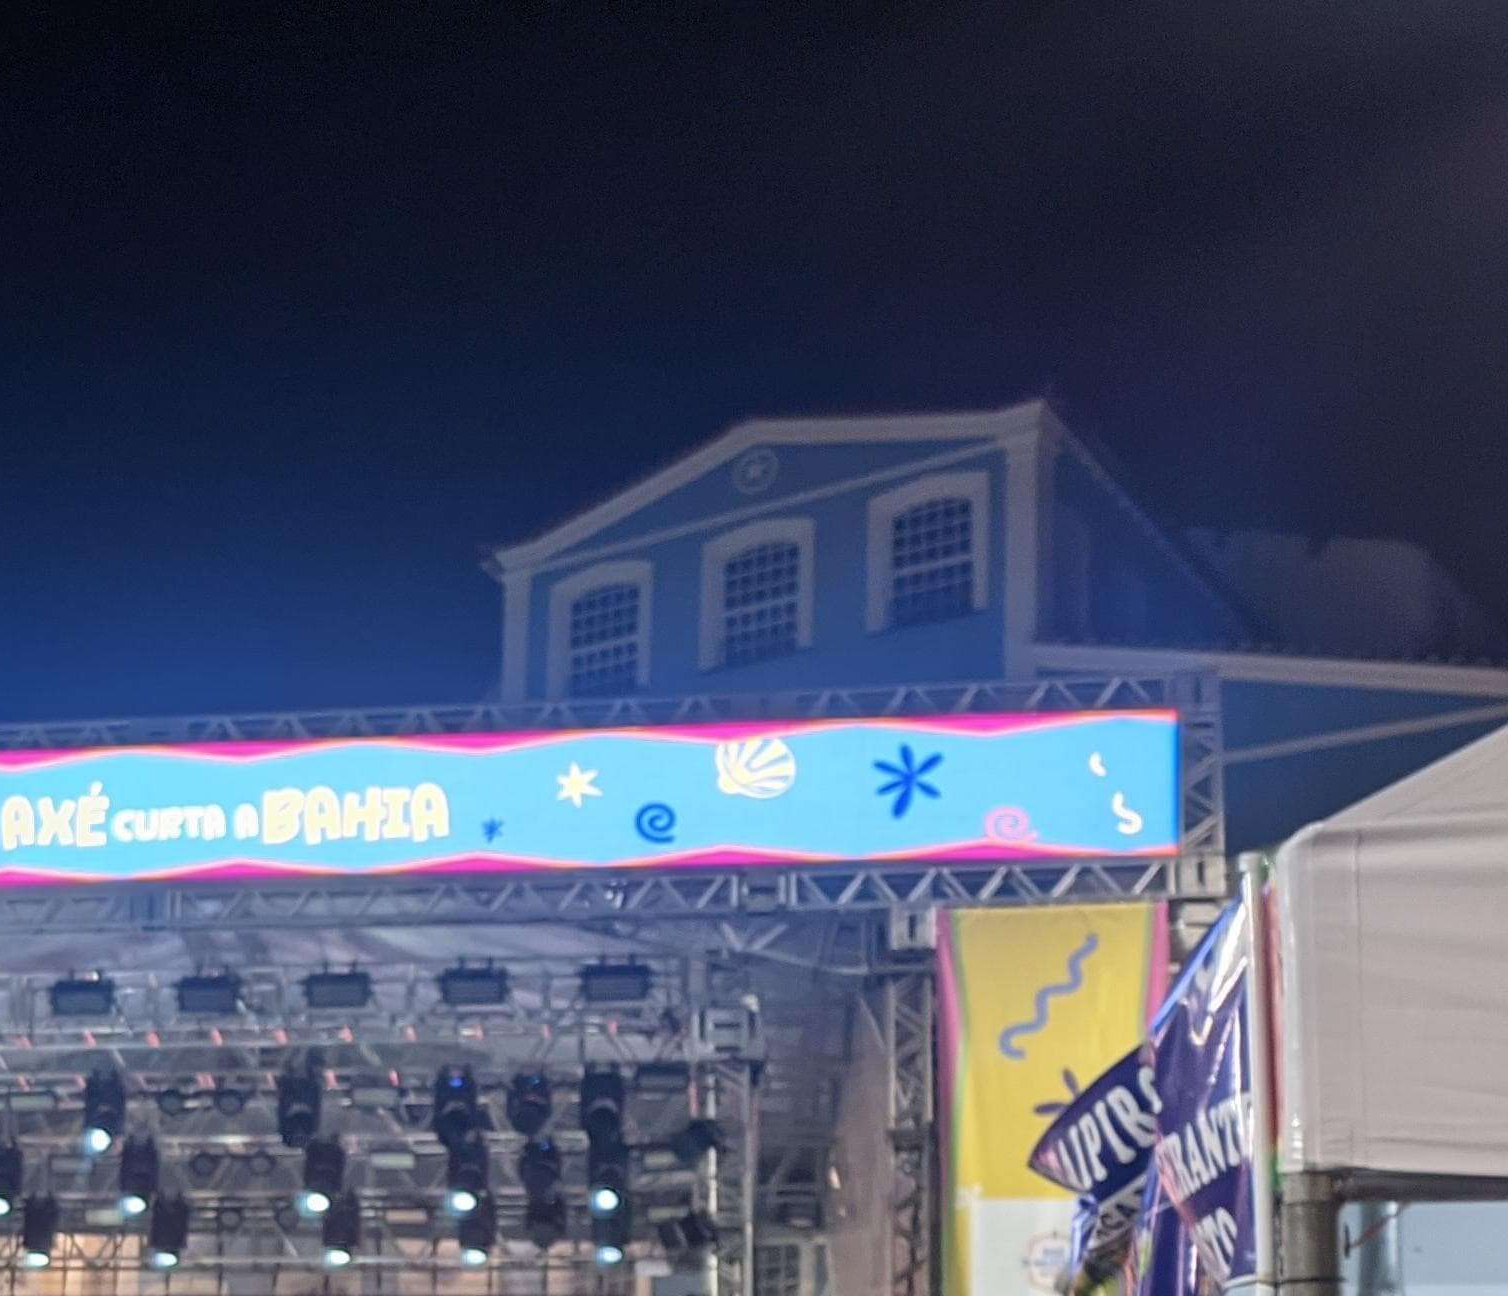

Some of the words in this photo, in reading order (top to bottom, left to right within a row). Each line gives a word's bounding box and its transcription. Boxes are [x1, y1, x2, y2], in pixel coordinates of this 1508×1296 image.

[0, 781, 110, 850] AXÉ
[112, 804, 227, 842] CURTA
[234, 803, 259, 840] A
[262, 782, 450, 845] BAHIA
